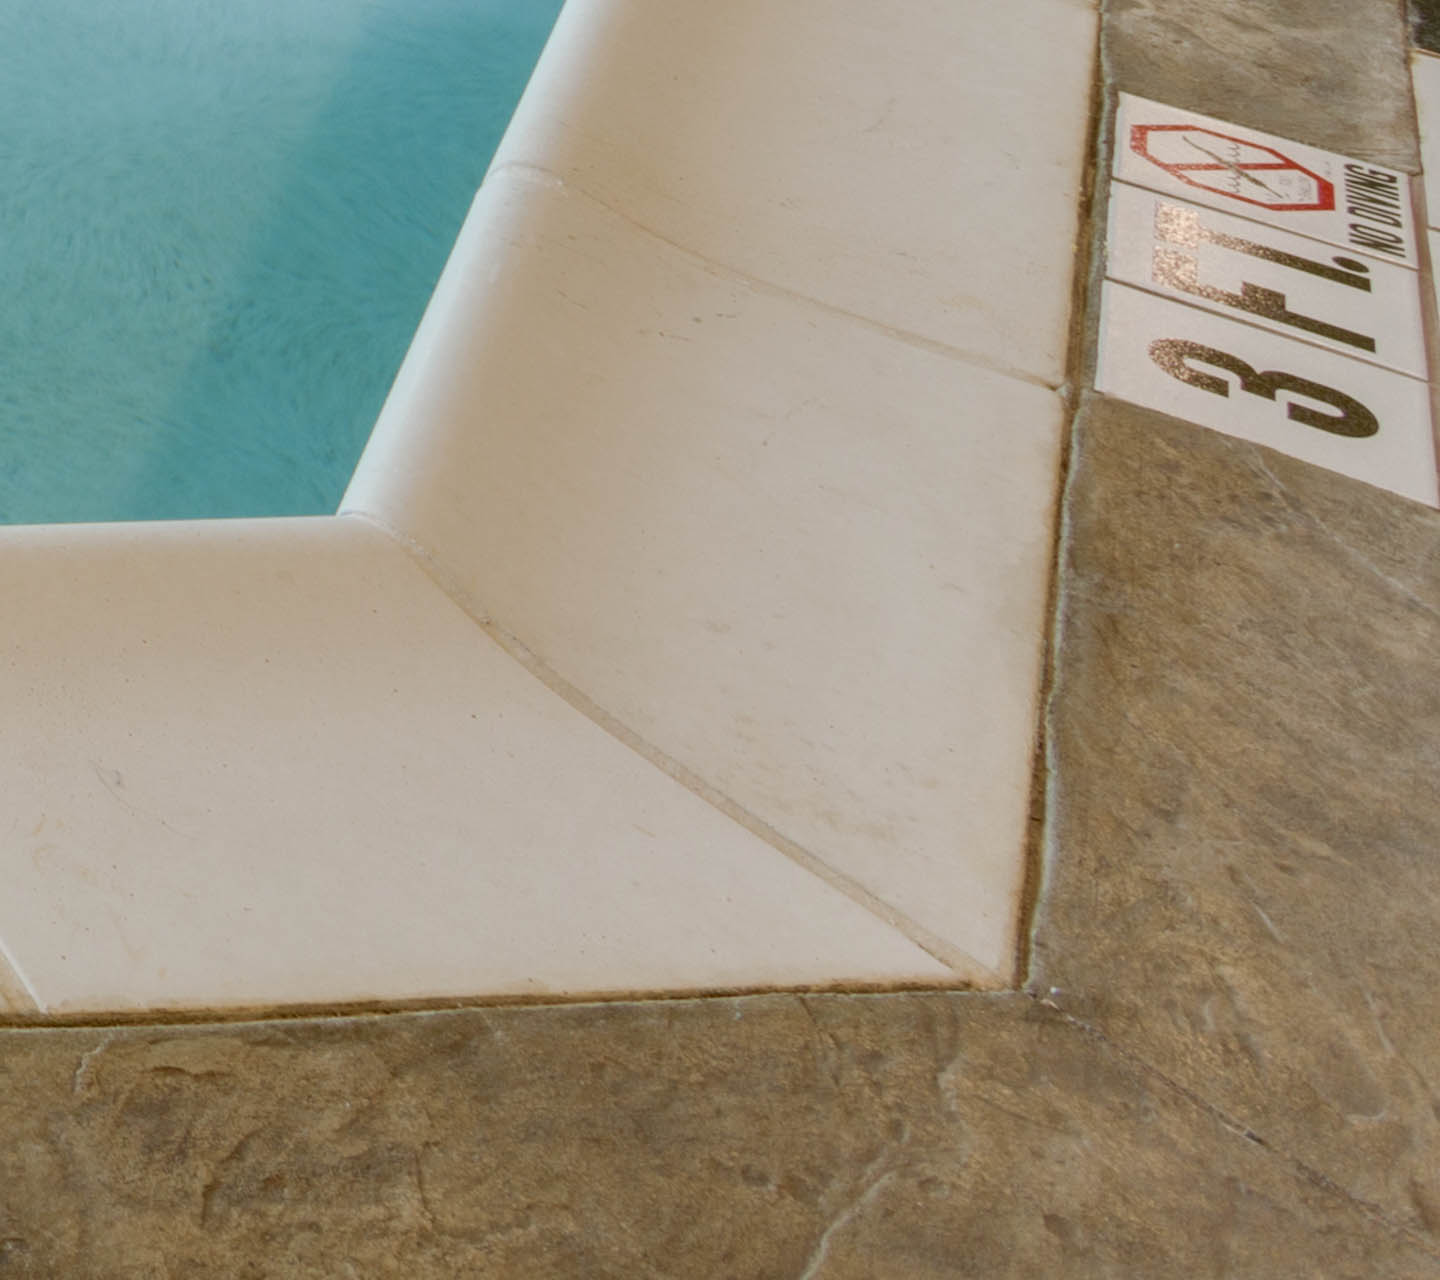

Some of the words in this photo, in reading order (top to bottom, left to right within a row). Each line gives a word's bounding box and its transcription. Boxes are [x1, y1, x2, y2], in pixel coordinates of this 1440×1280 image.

[1343, 163, 1403, 229] DIVING
[1151, 198, 1378, 354] FT.
[1347, 223, 1407, 258] NO
[1147, 337, 1380, 439] 3
